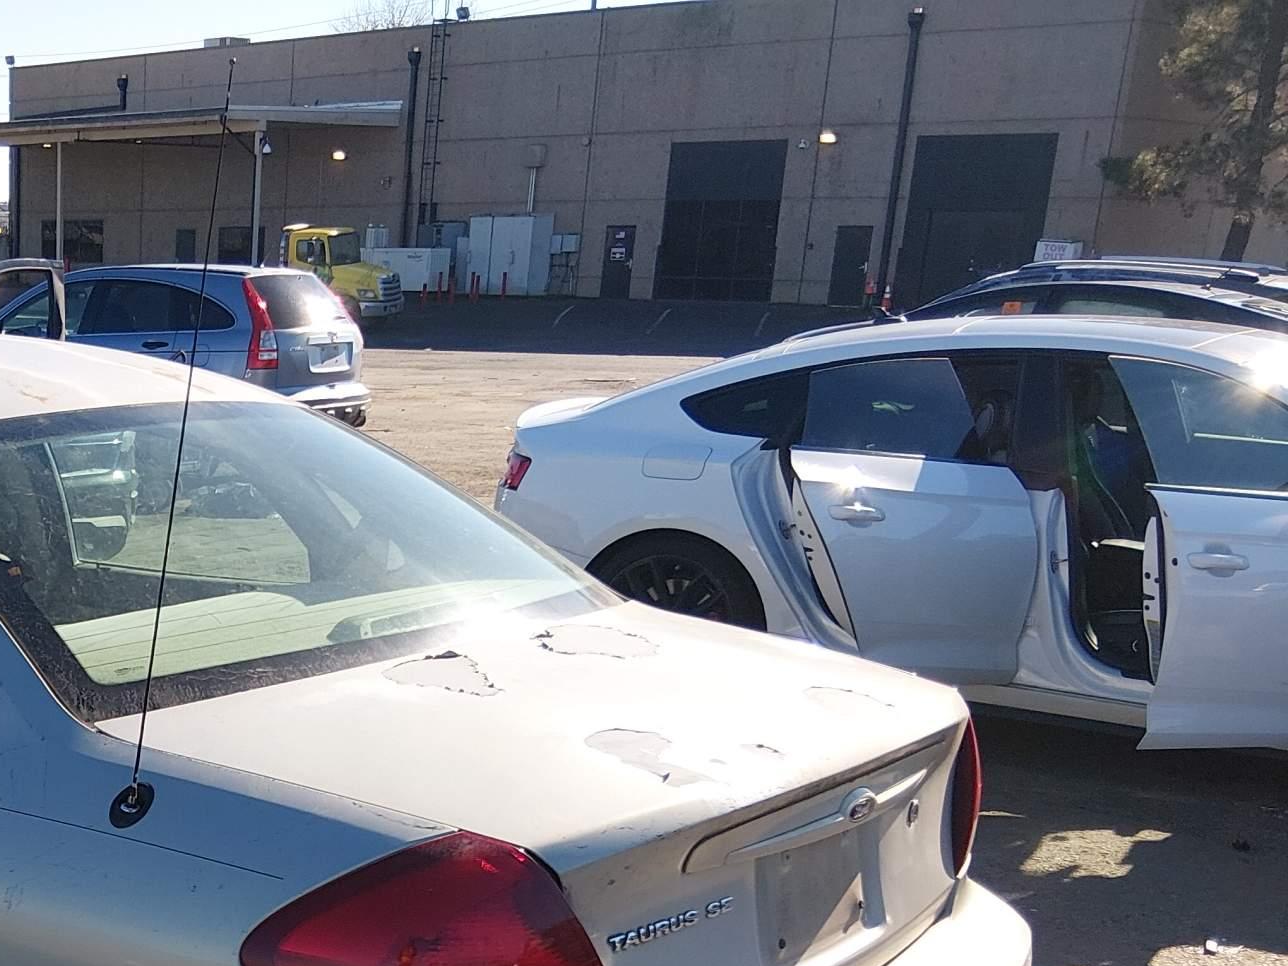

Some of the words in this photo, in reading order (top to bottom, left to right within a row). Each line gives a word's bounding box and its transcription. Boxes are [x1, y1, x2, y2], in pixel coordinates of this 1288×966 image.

[1043, 243, 1068, 252] TOW
[607, 909, 699, 952] TAURUS
[705, 896, 734, 919] SE
